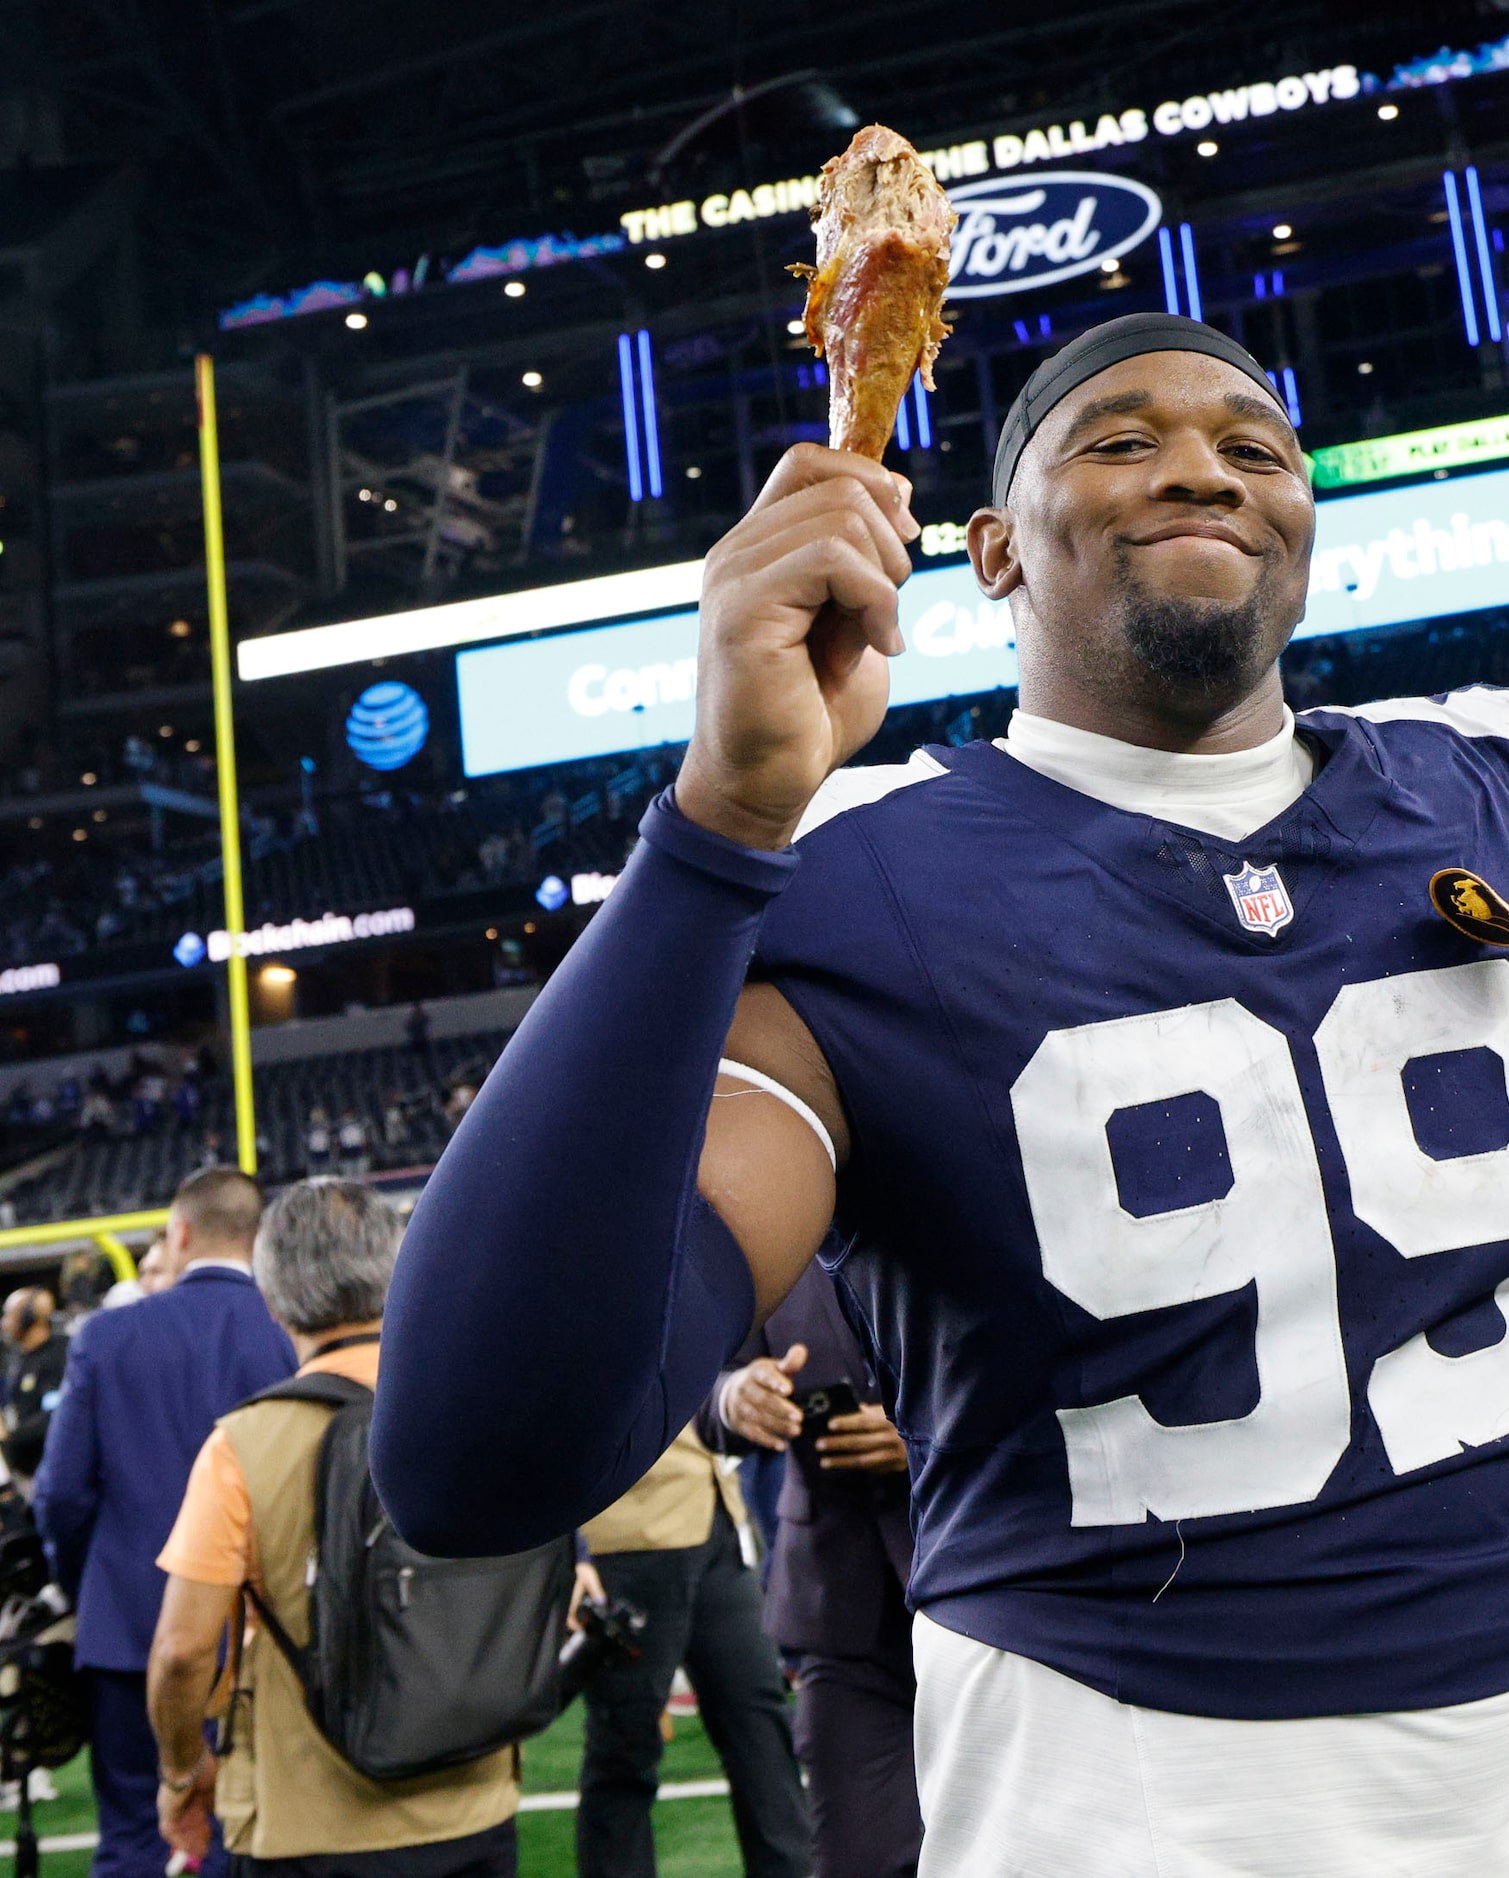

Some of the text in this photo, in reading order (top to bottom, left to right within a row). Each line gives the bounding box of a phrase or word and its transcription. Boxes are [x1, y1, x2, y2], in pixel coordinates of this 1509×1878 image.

[620, 200, 698, 244] THE
[701, 174, 826, 227] CASIN
[993, 109, 1149, 169] DALLAS
[1153, 64, 1361, 136] COWBOYS
[949, 189, 1101, 282] Ford
[207, 907, 415, 963] Bockchain.com
[1242, 894, 1285, 923] NFL
